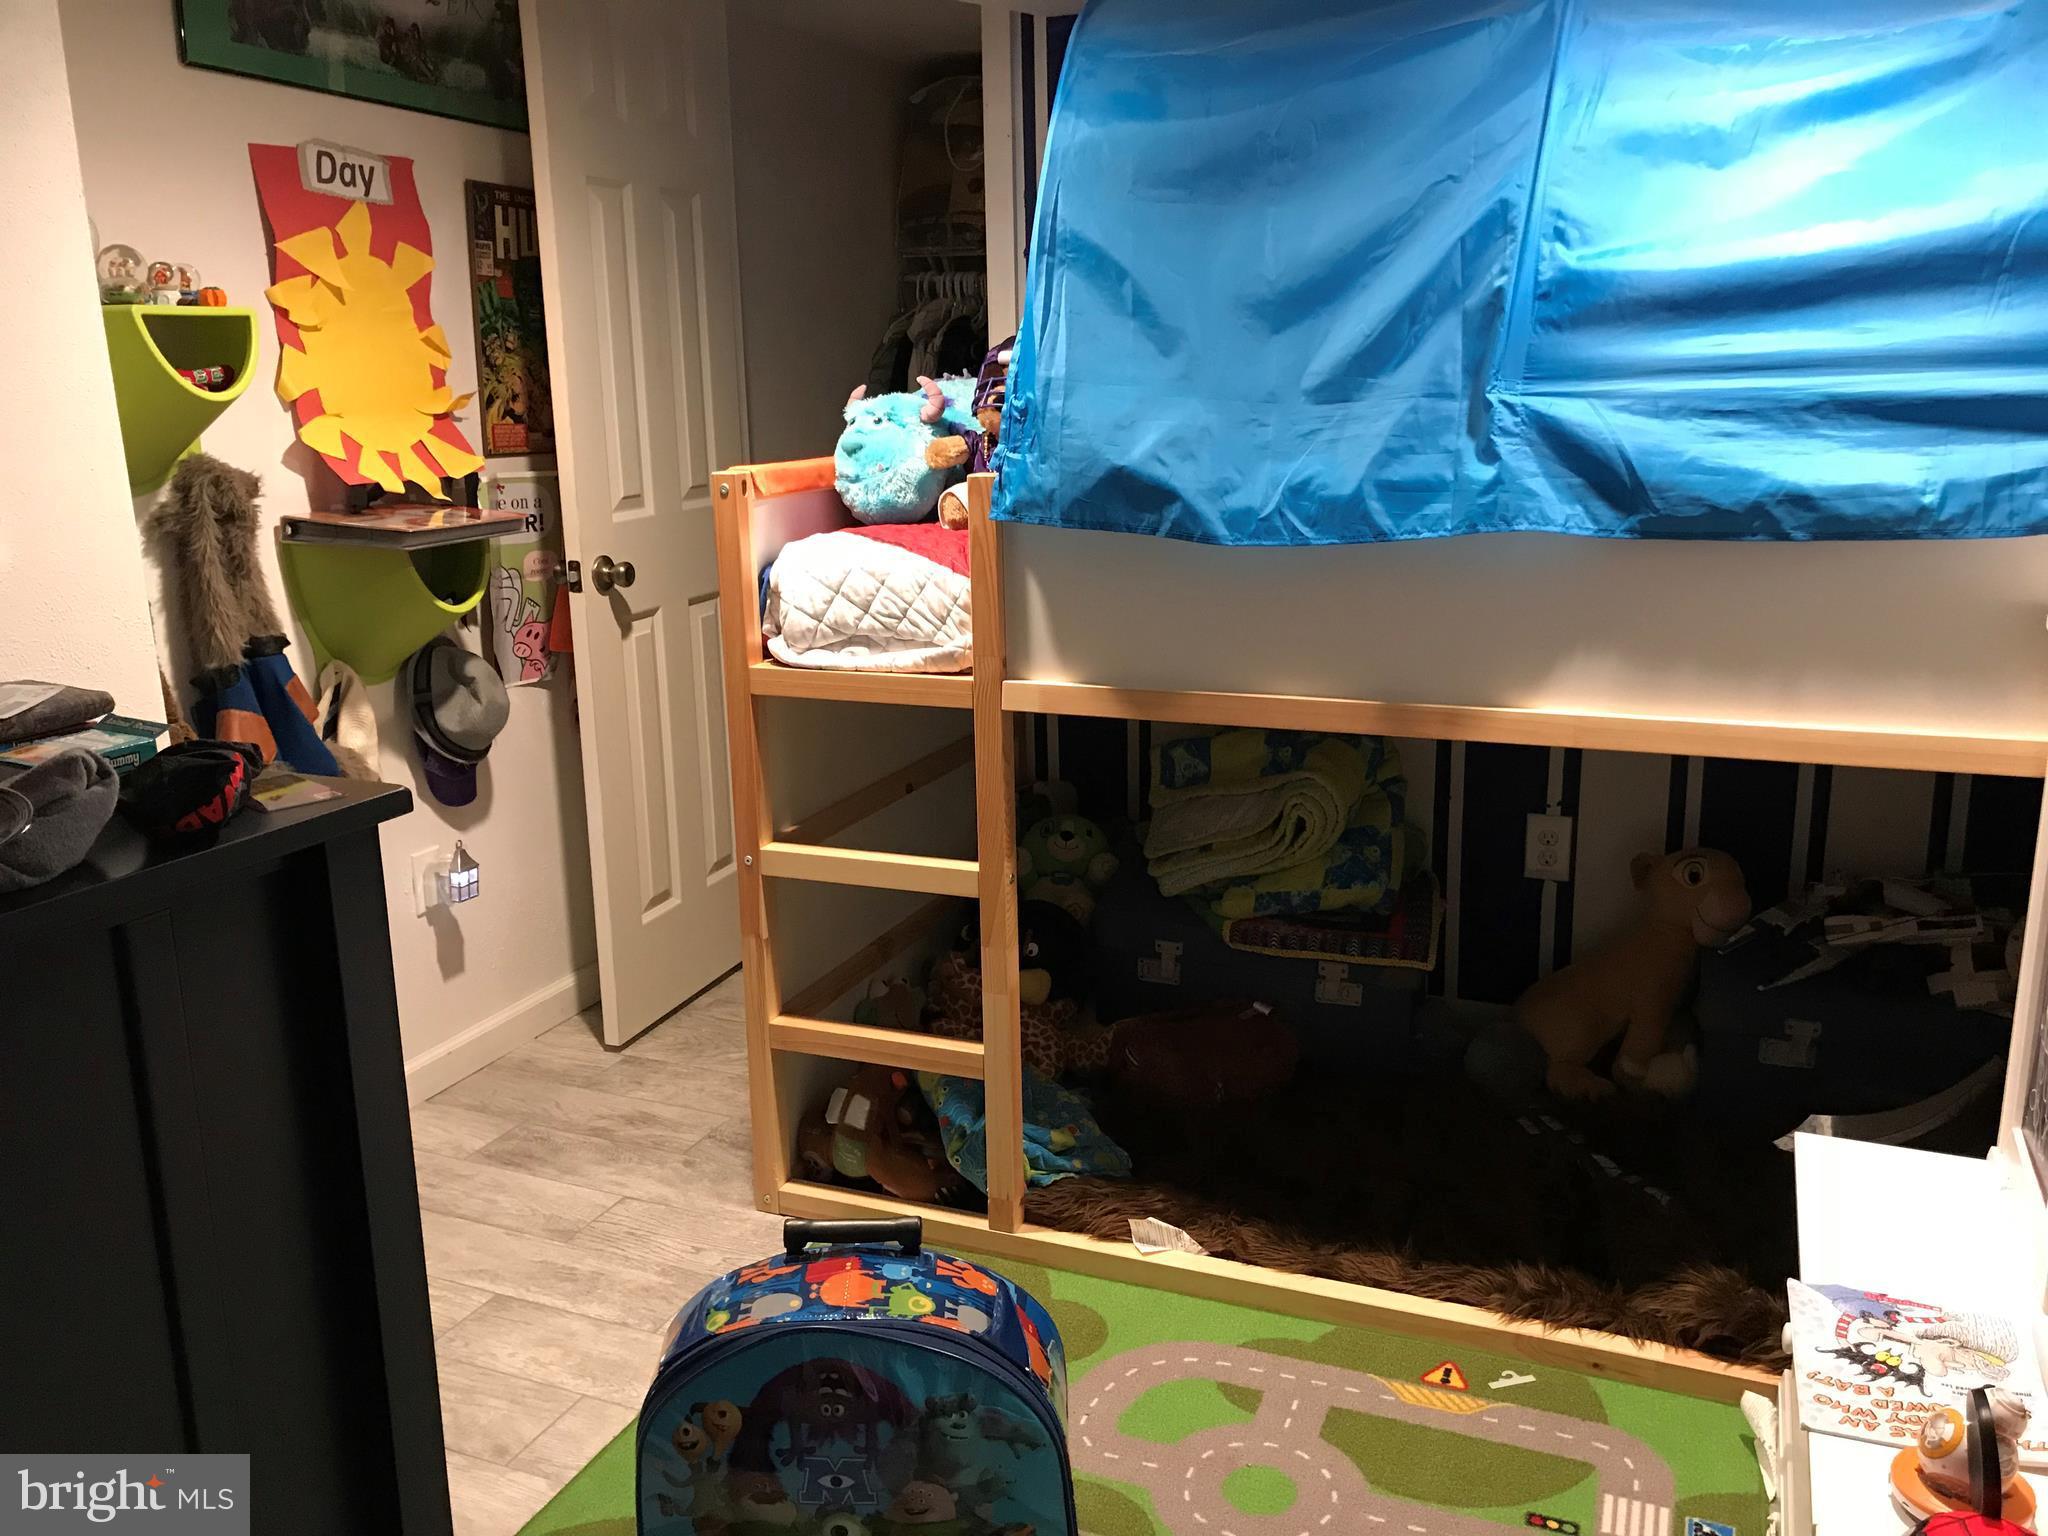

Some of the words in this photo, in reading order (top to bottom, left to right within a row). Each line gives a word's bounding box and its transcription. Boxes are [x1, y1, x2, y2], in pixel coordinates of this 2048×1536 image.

[316, 150, 375, 197] Day
[494, 190, 511, 201] THE
[511, 497, 528, 509] on
[534, 497, 542, 509] a
[110, 752, 140, 767] ummy
[1806, 1371, 1871, 1396] BAT!
[1876, 1386, 1895, 1397] A
[1813, 1394, 1877, 1420] WHO
[1839, 1415, 1880, 1432] AN
[1885, 1412, 1924, 1426] DY
